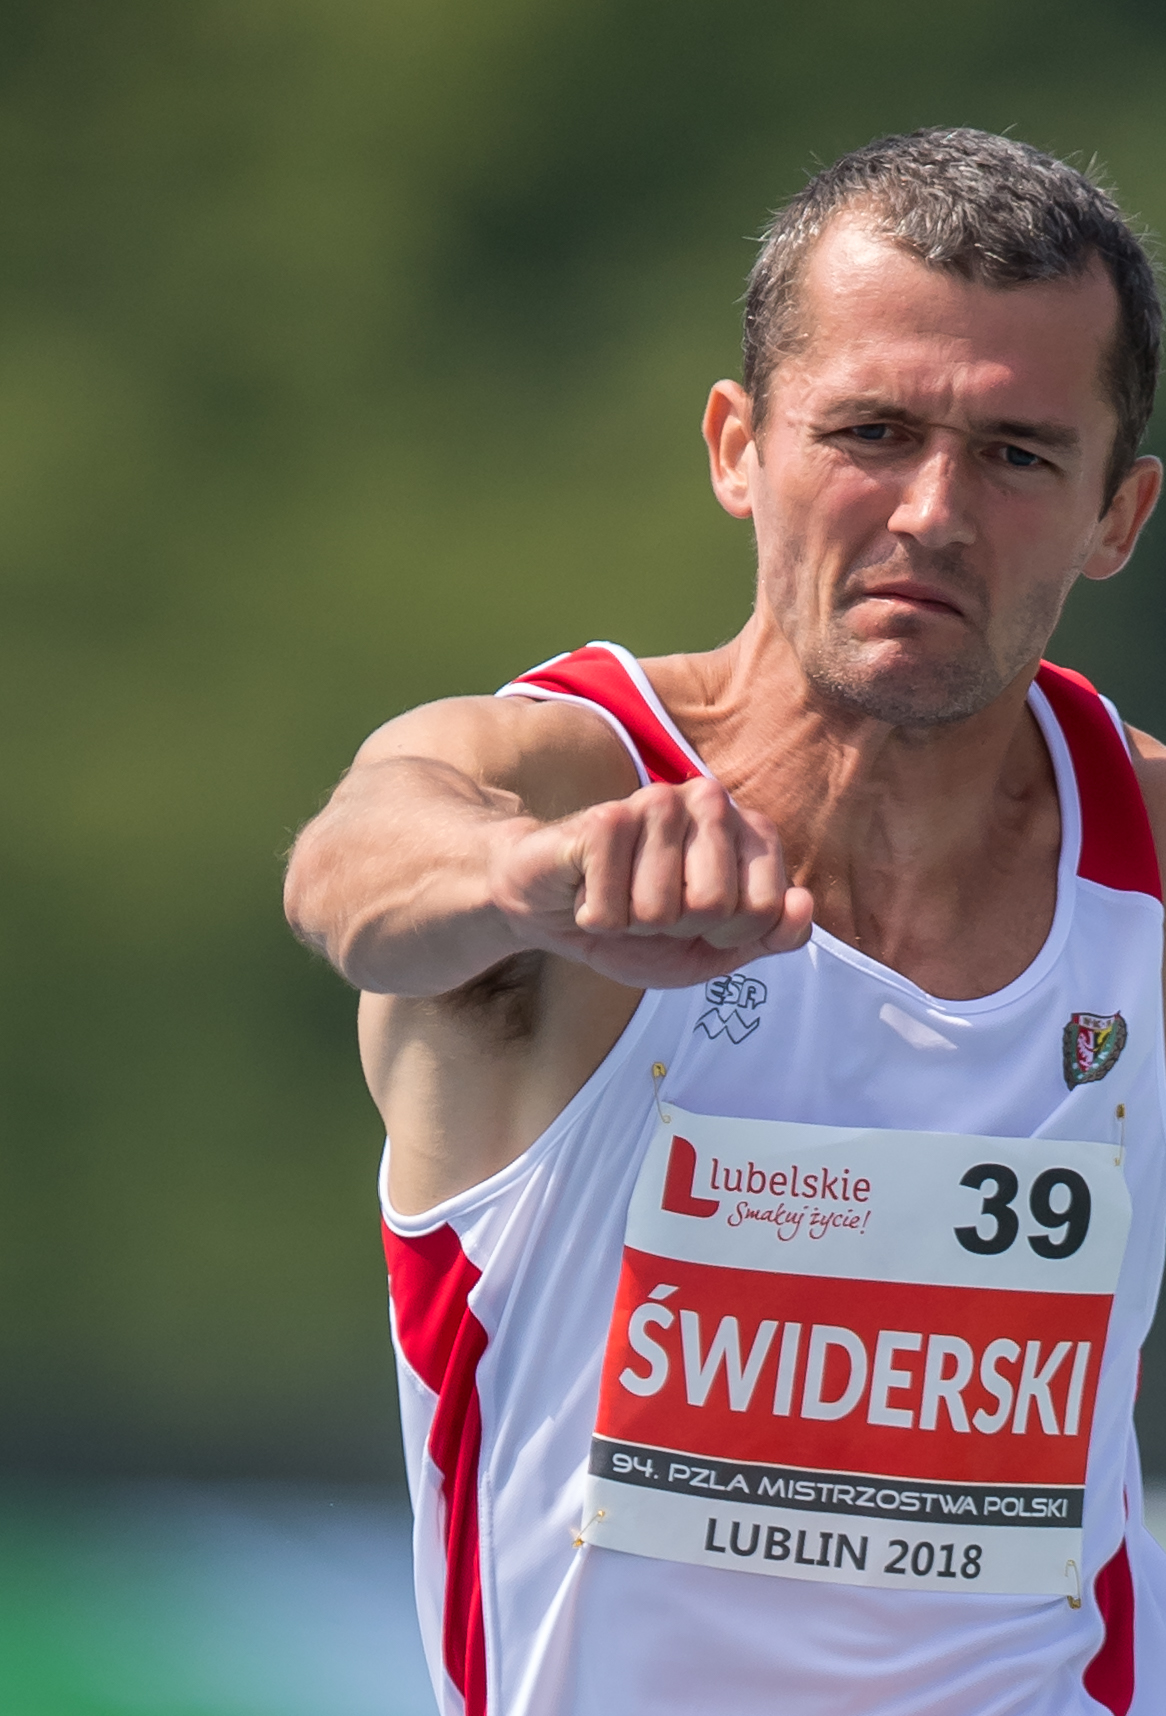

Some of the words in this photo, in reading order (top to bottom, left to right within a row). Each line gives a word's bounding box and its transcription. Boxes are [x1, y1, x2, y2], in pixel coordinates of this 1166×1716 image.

[710, 1157, 871, 1203] lubelskie
[953, 1162, 1092, 1260] 39
[727, 1201, 809, 1242] Smakuj
[809, 1206, 872, 1240] życie!
[618, 1283, 1092, 1437] ŚWIDERSKI
[612, 1452, 659, 1480] 94.
[668, 1462, 750, 1495] PZLA
[757, 1475, 978, 1516] MISTRZOSTWA
[983, 1496, 1068, 1519] POLSKI
[704, 1516, 869, 1571] LUBLIN
[884, 1538, 983, 1580] 2018
